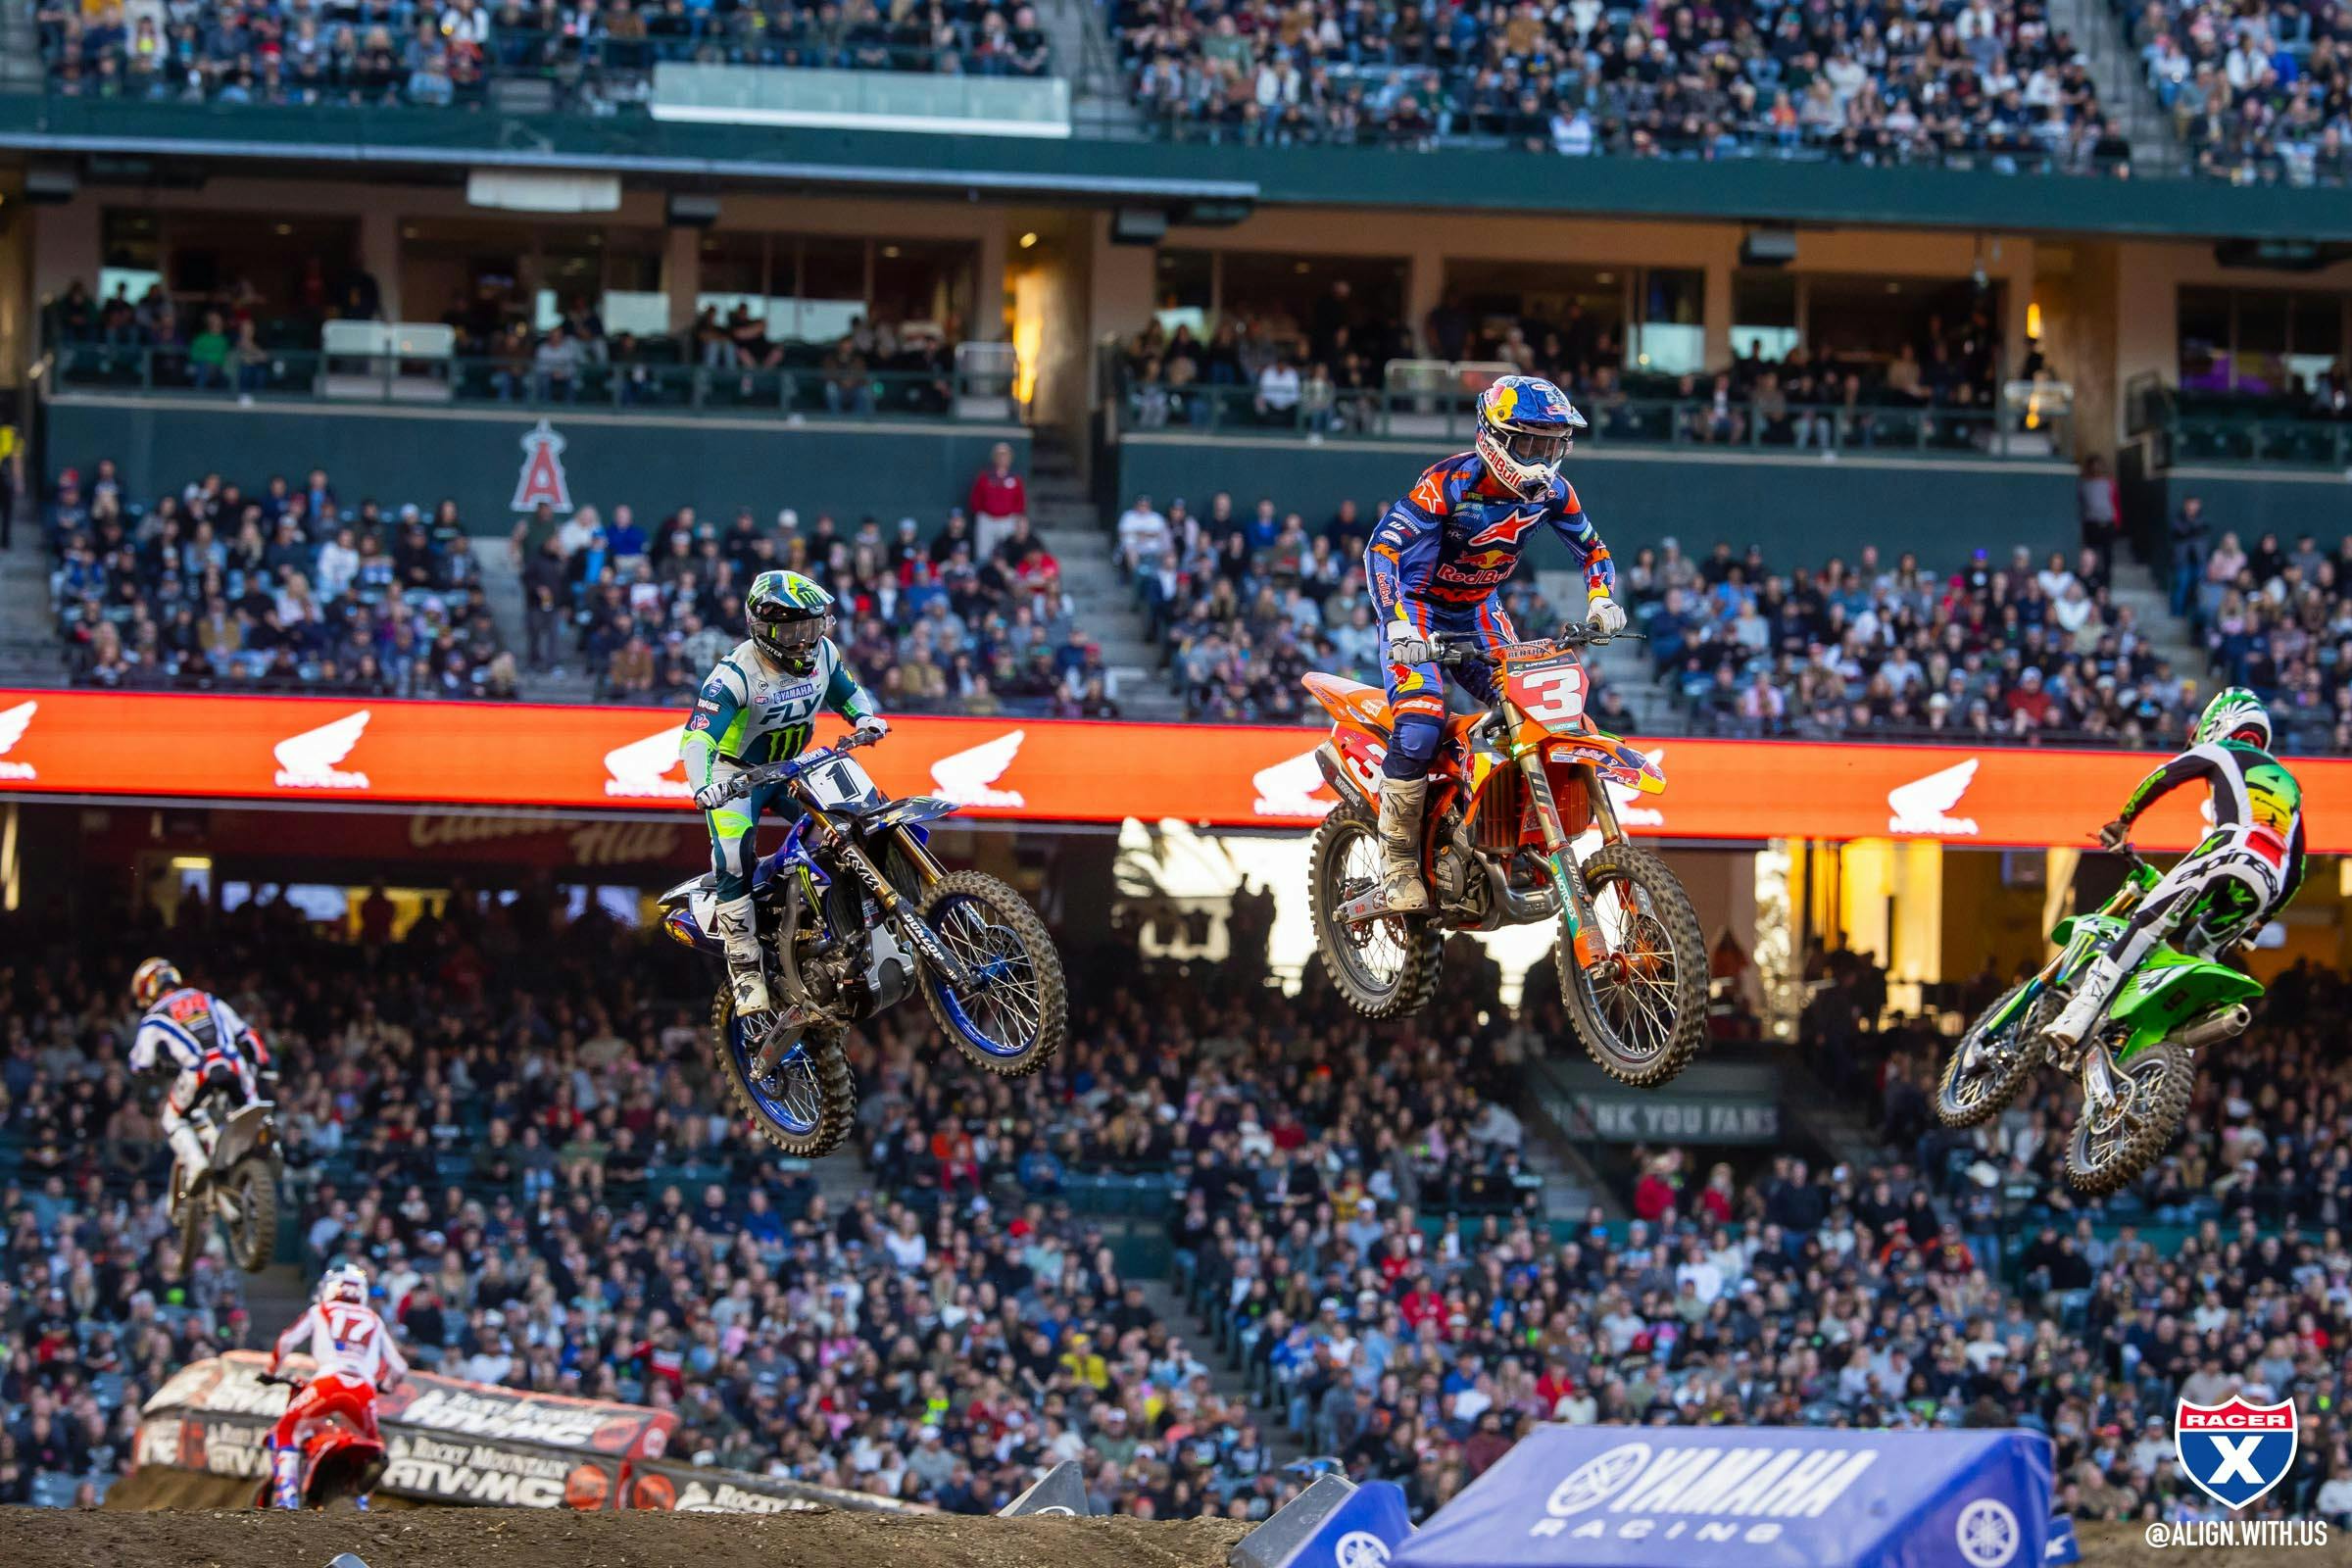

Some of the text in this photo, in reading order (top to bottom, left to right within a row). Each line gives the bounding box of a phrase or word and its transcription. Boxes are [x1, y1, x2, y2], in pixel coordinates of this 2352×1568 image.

[759, 693, 821, 725] FLY
[780, 684, 813, 702] YAMAHA
[1522, 668, 1582, 722] 3
[825, 760, 860, 802] 1
[1553, 873, 1580, 921] MOTOREX
[902, 912, 946, 960] DUNLOP
[328, 1310, 376, 1344] 17
[1608, 1446, 1879, 1519] YAMAHA
[1529, 1517, 1784, 1544] RACING
